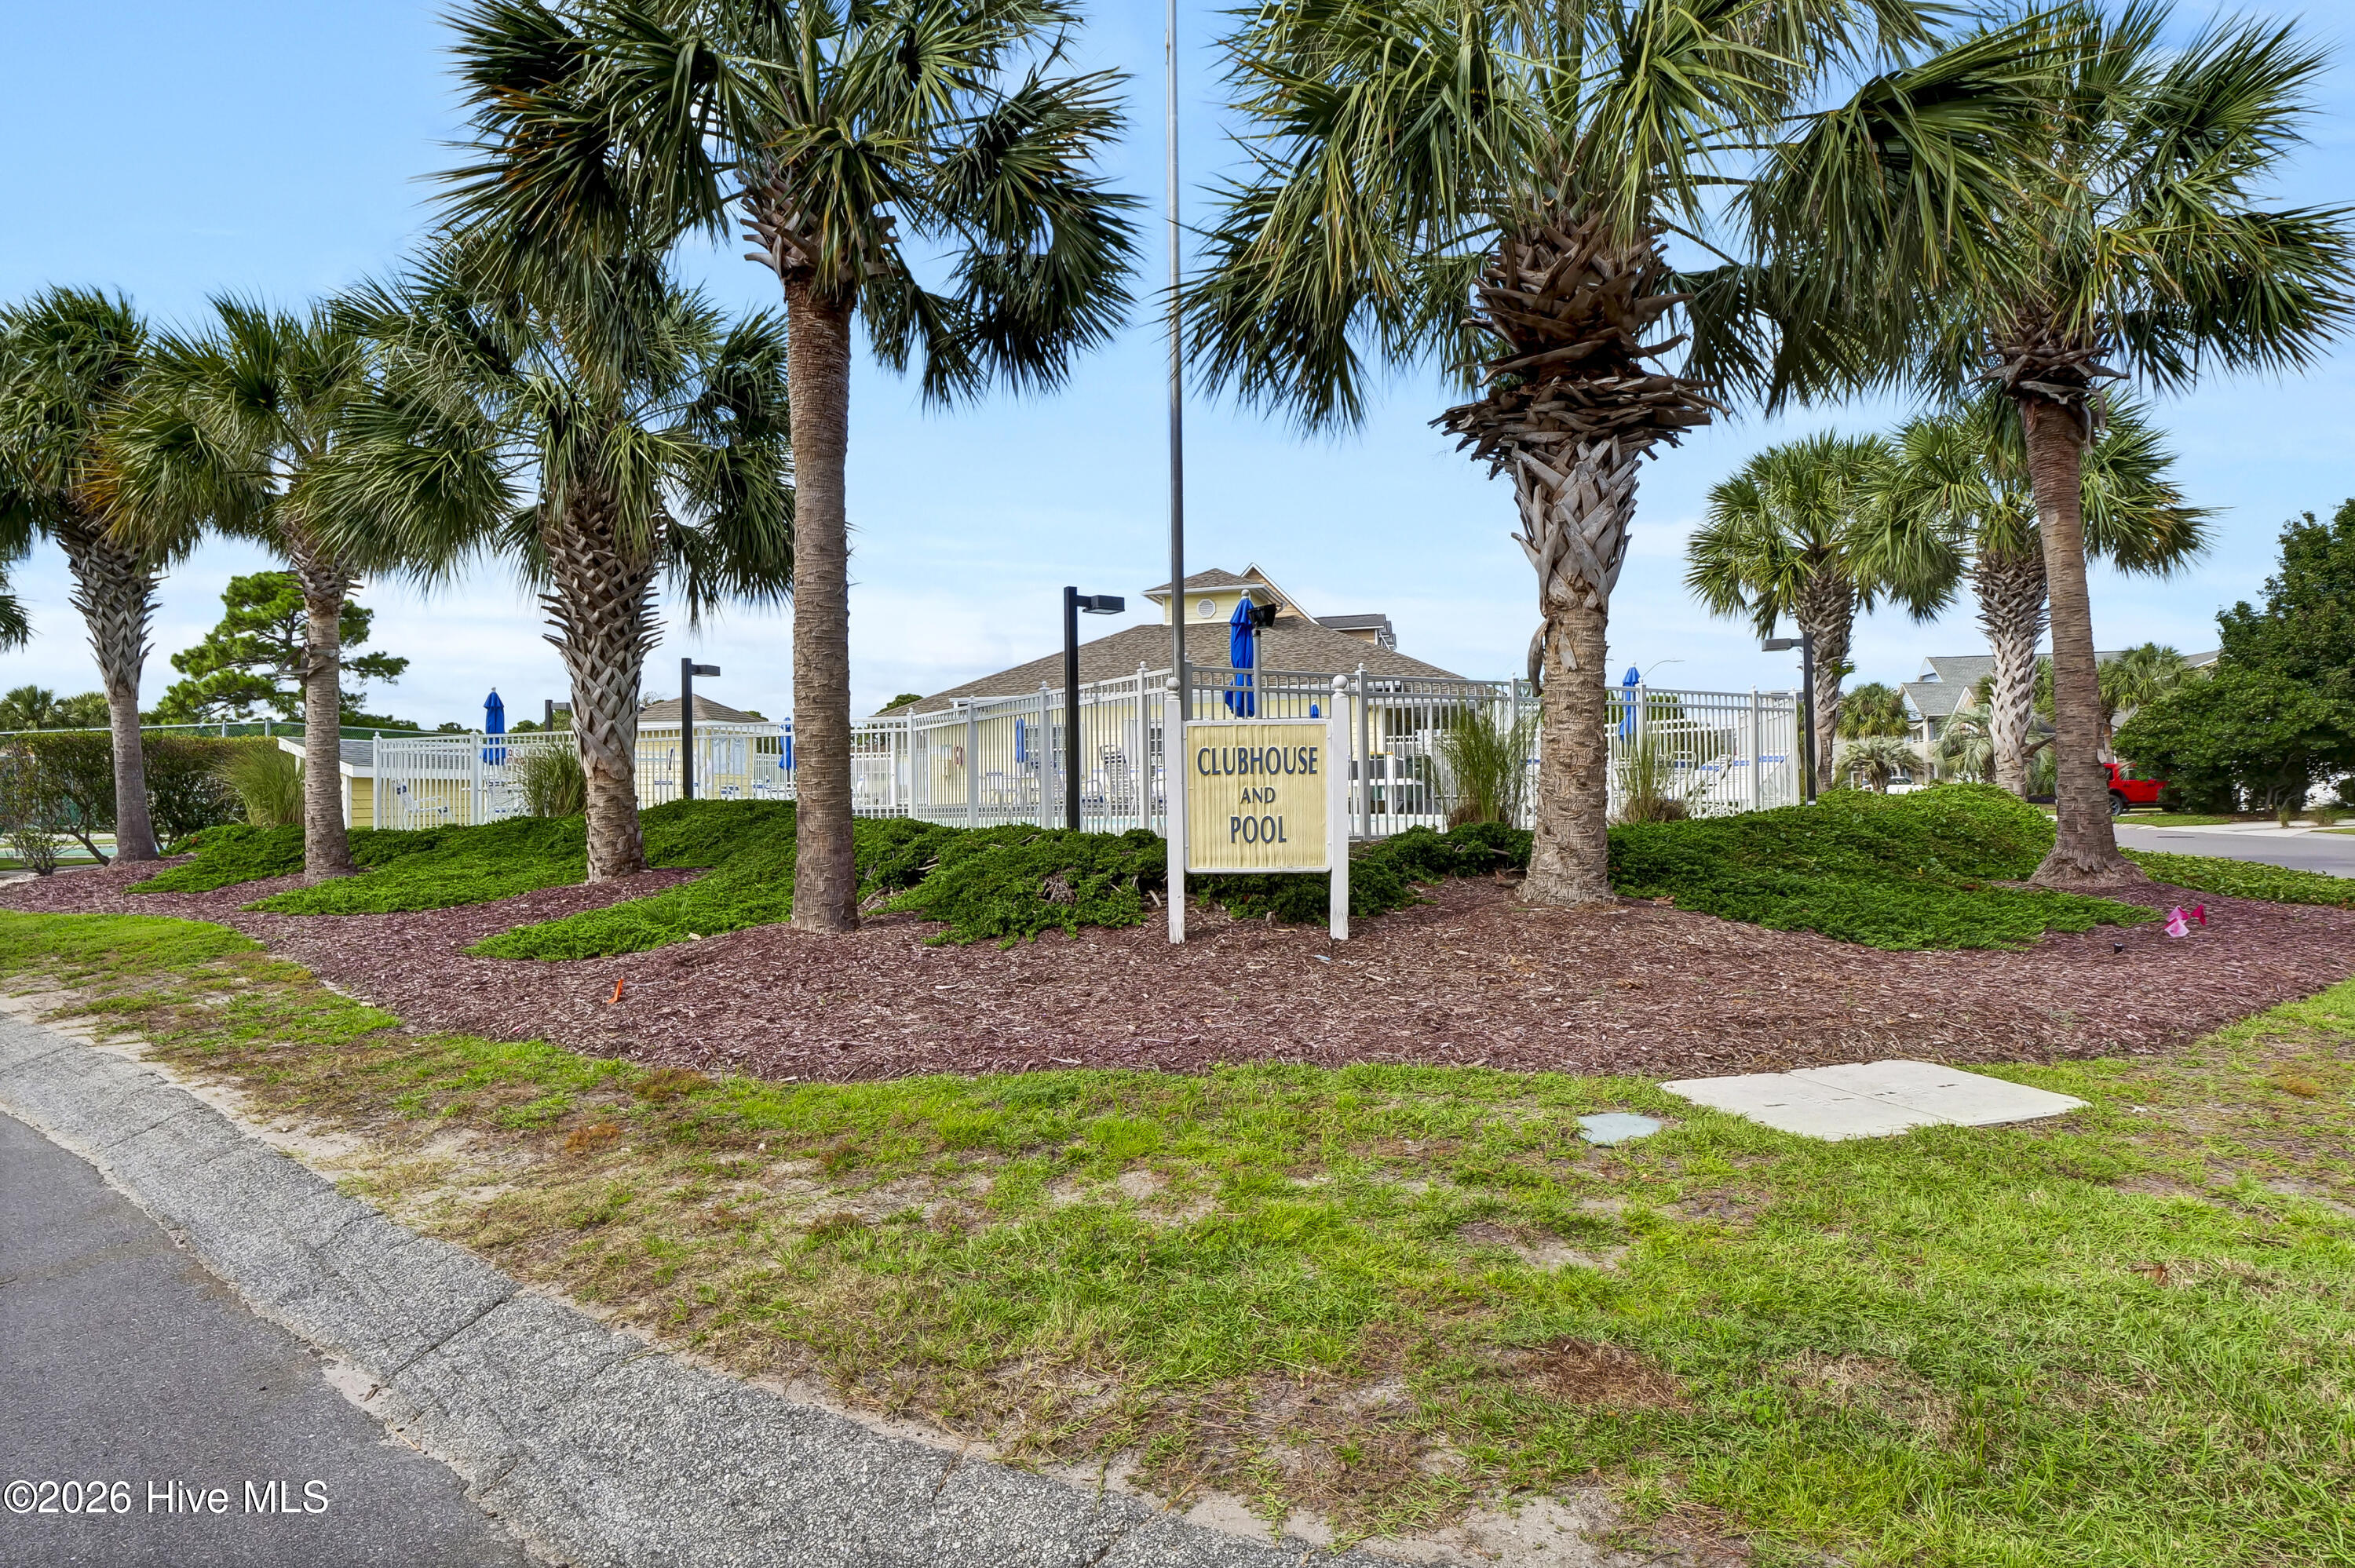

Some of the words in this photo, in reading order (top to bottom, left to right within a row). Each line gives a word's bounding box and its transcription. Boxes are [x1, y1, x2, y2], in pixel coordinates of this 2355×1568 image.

[1197, 746, 1318, 775] CLUBHOUSE
[1240, 786, 1276, 804] AND
[1230, 815, 1287, 844] POOL
